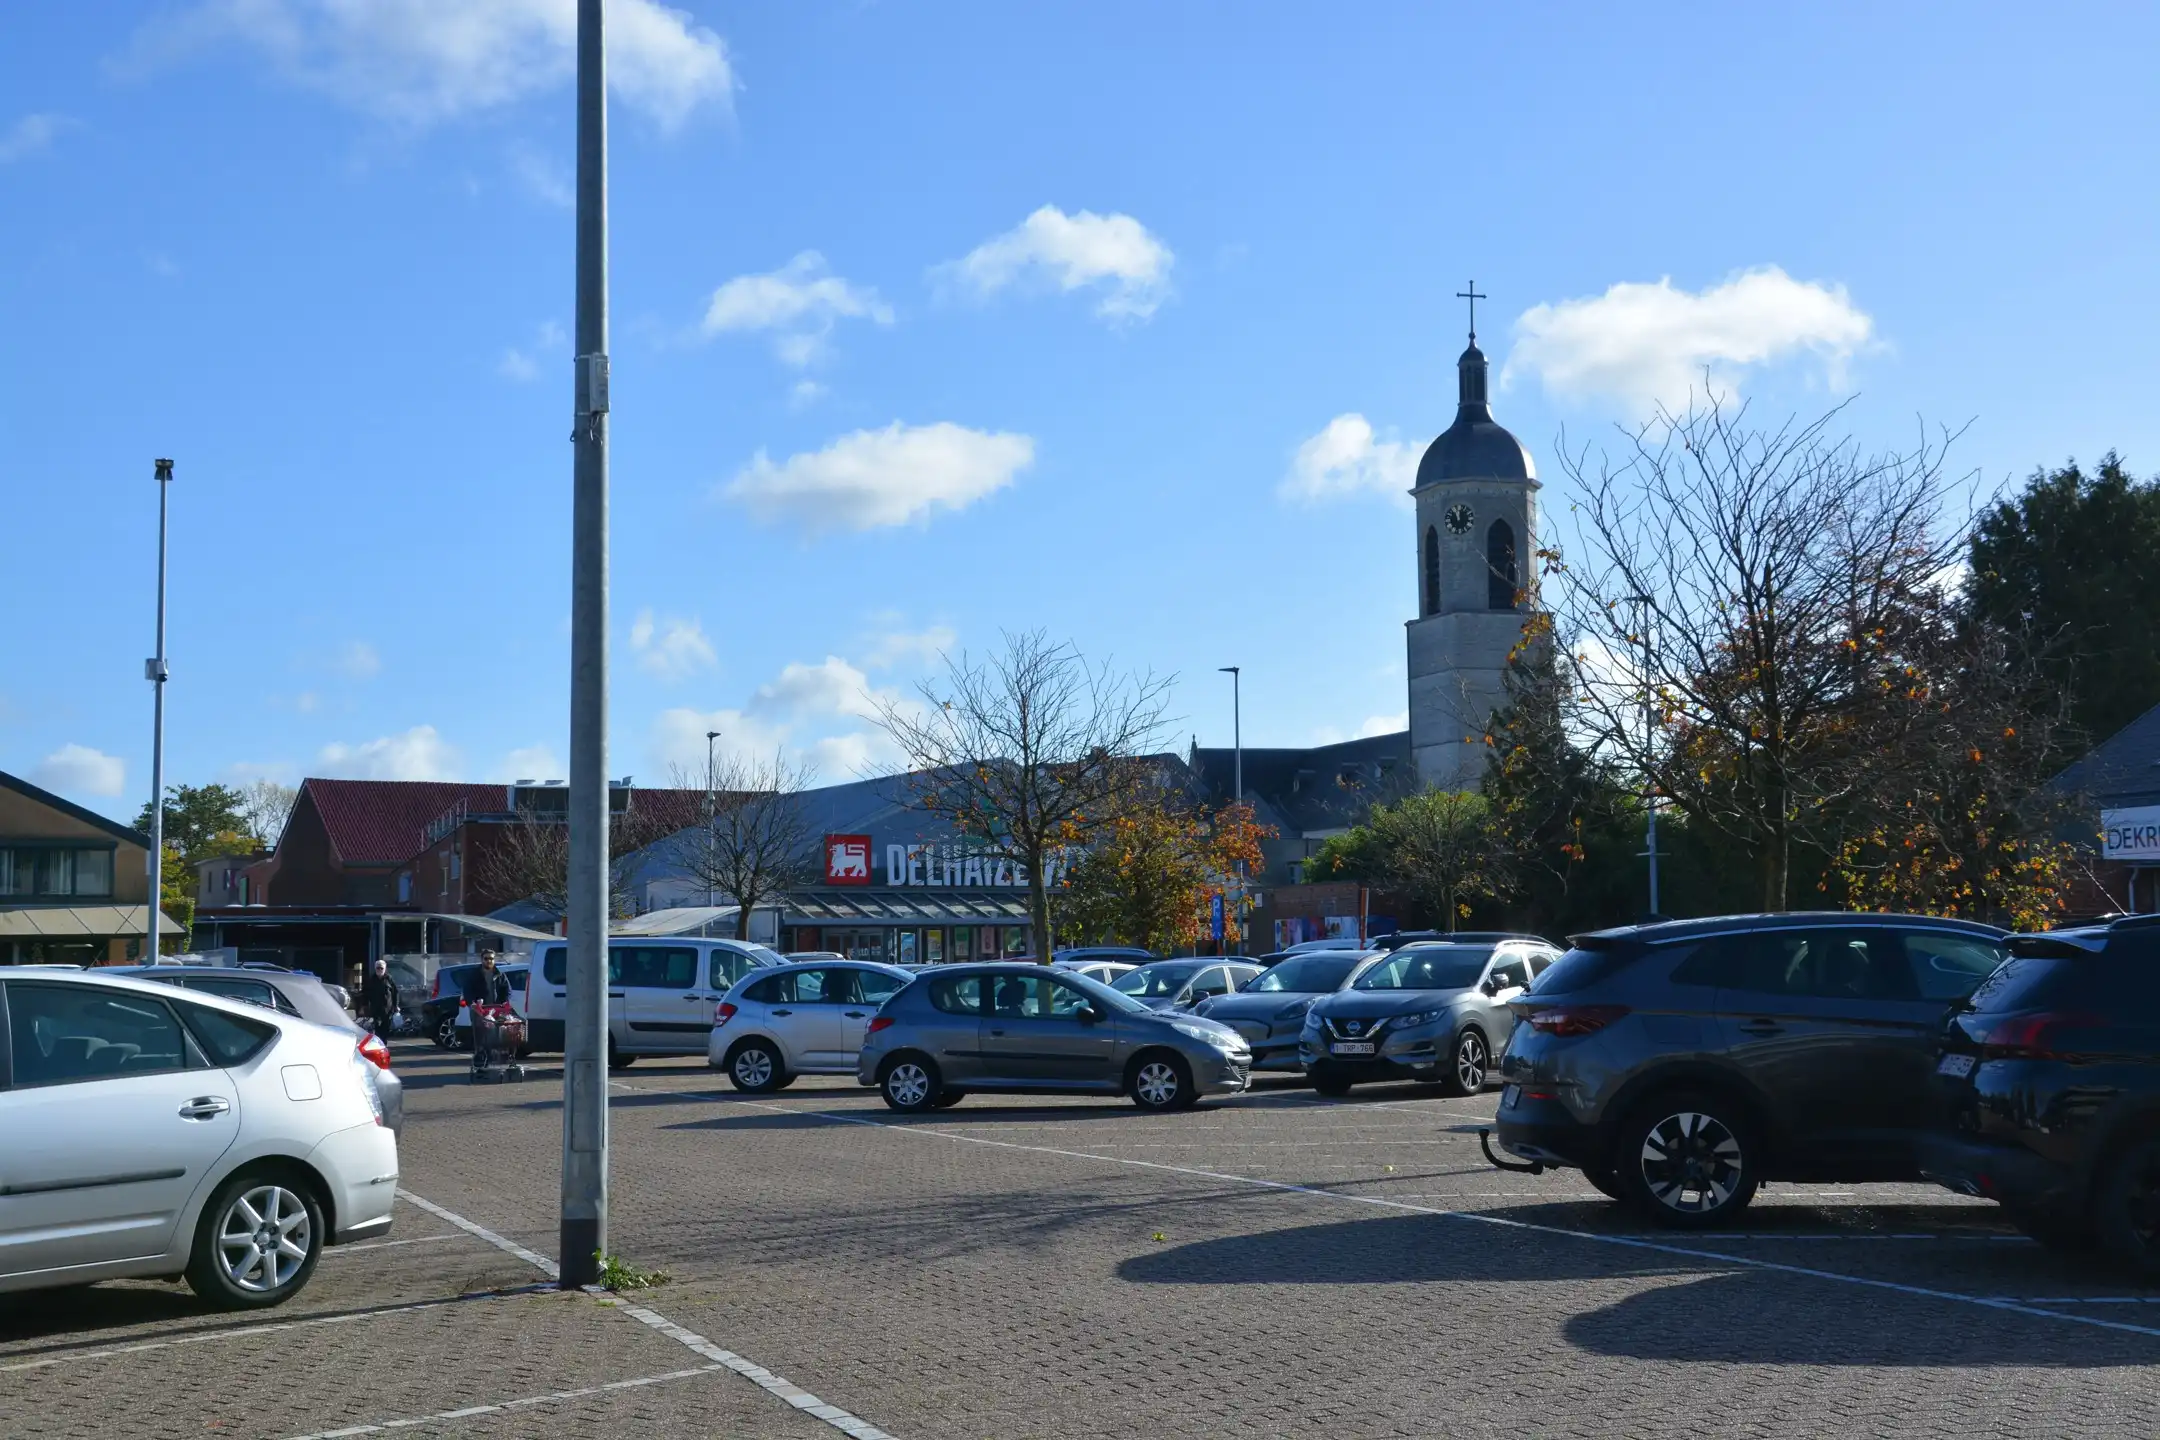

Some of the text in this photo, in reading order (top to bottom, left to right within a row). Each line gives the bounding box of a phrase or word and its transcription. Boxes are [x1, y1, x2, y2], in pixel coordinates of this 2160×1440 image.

[2108, 825, 2160, 850] DEKR
[886, 844, 1029, 887] DELHAIZE
[1212, 898, 1221, 917] P
